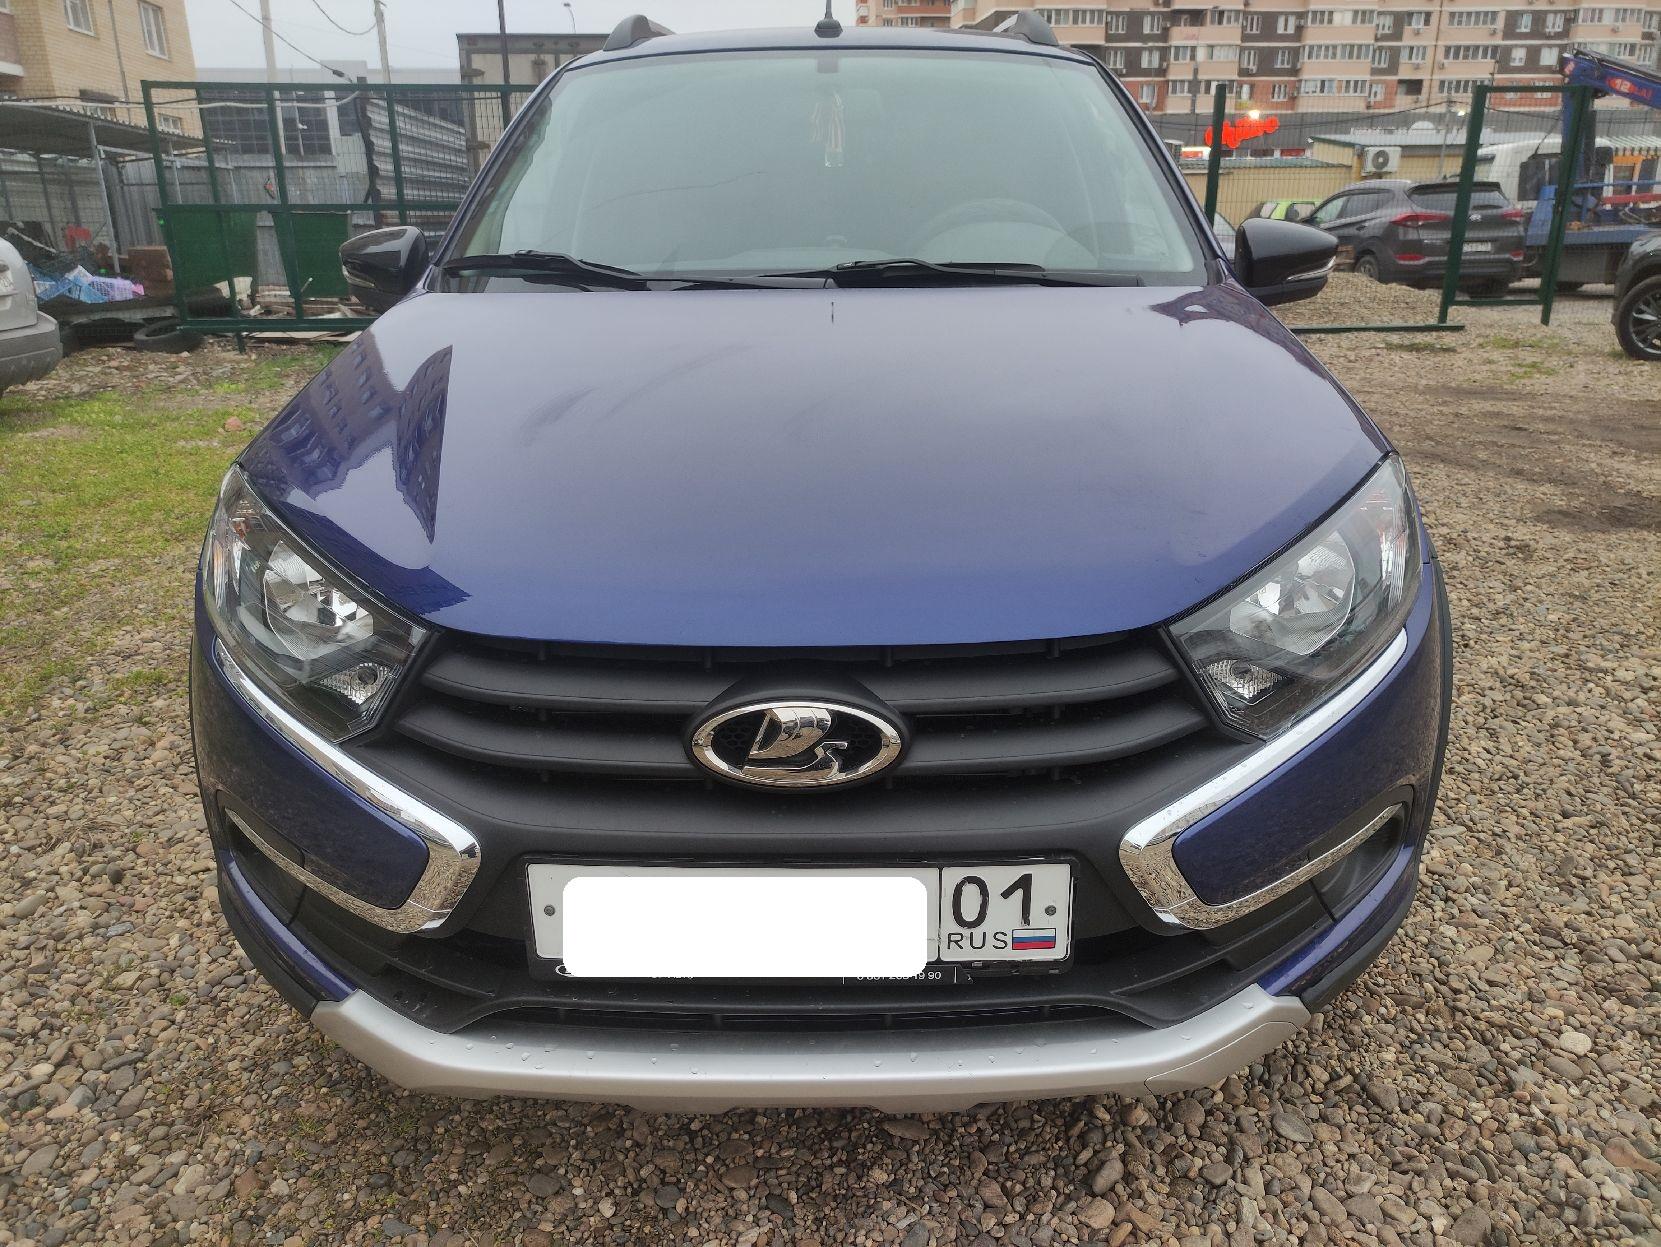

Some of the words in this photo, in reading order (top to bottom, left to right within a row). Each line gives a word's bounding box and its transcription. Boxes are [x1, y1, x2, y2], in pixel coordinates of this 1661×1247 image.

[952, 873, 1032, 929] 01
[947, 931, 1008, 950] RUS
[927, 971, 942, 980] 90
